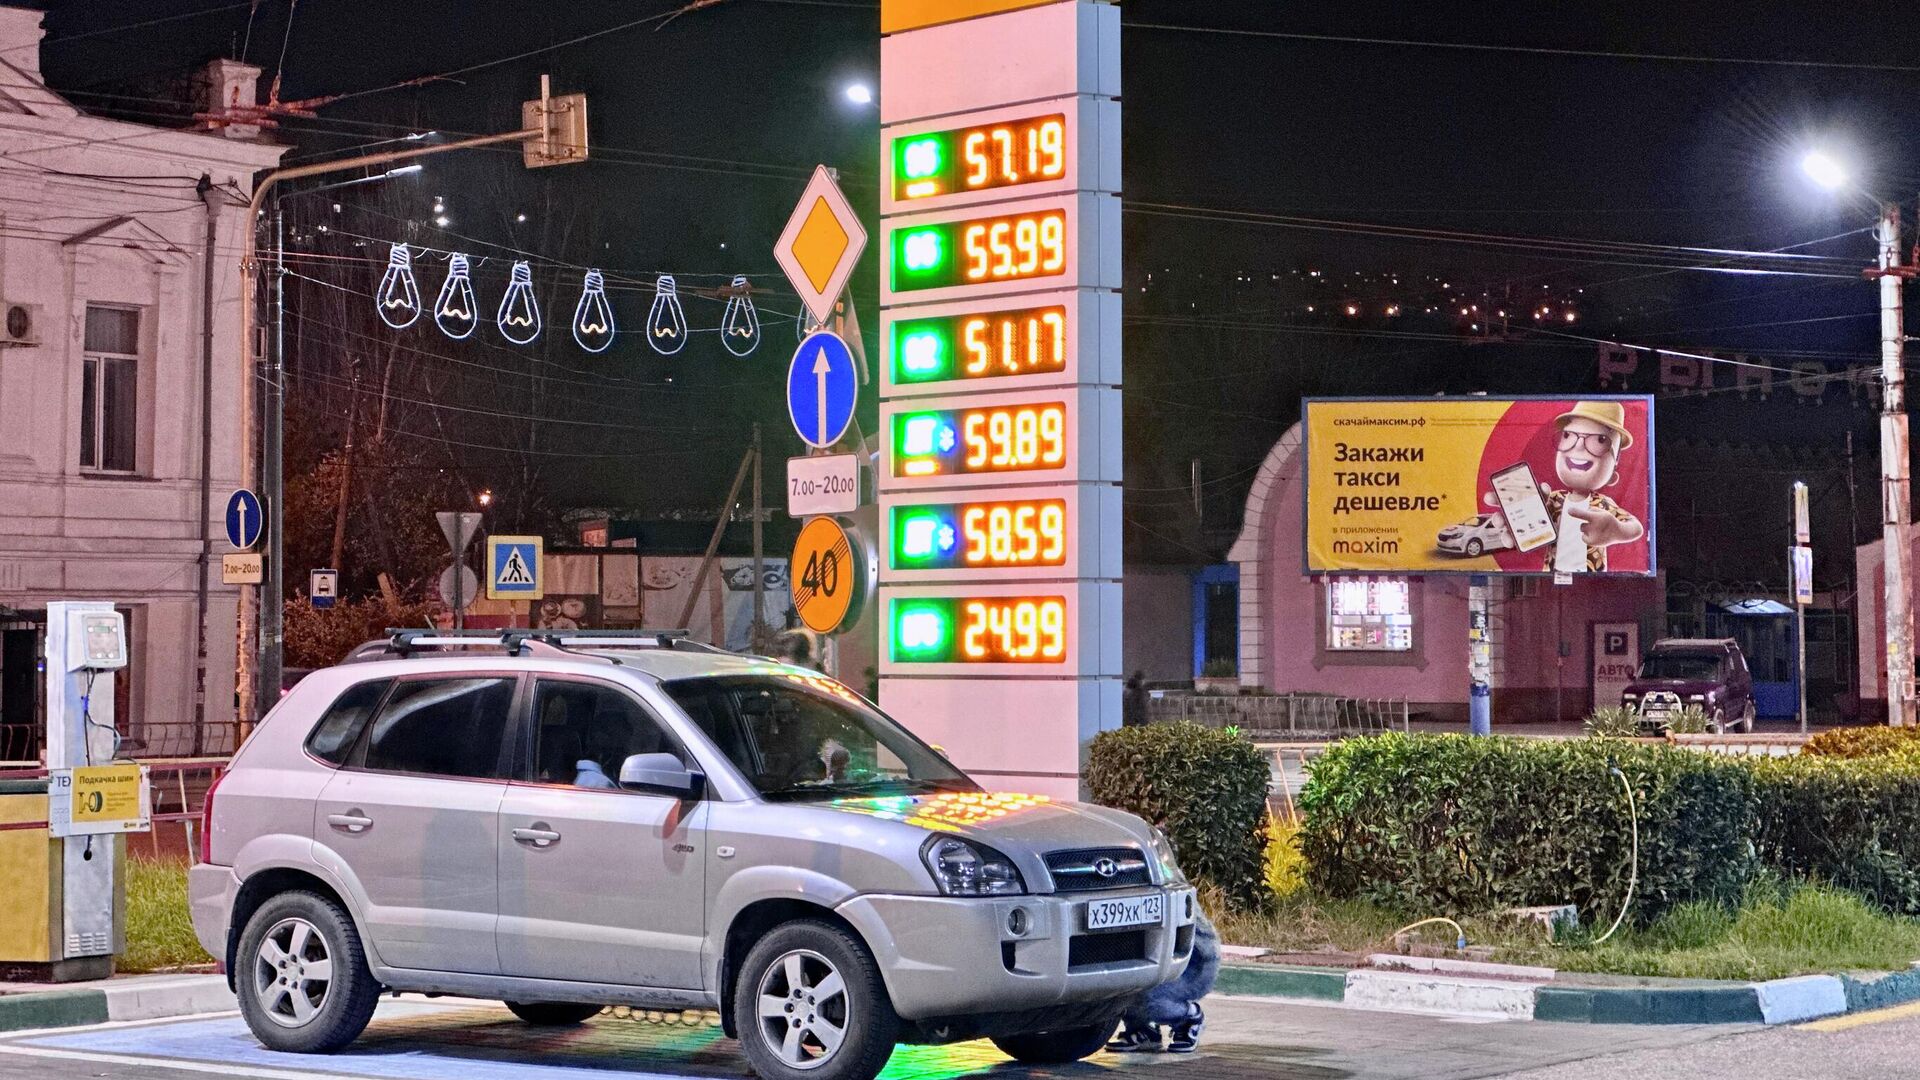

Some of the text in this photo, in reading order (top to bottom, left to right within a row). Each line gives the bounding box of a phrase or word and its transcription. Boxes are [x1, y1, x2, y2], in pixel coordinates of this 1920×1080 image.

[965, 121, 1063, 185] 57.19
[965, 215, 1063, 278] 55.99
[965, 312, 1063, 373] 51.17
[1333, 415, 1426, 428] скачаймаксим.рф
[964, 408, 1063, 467] 59.89
[1334, 442, 1425, 462] Закажи
[791, 475, 854, 496] 7.00-20.00
[1334, 471, 1400, 487] такси
[964, 504, 1063, 562] 58.59
[1340, 526, 1399, 535] приложении
[1333, 536, 1398, 554] maxim
[801, 549, 838, 598] 40
[964, 602, 1063, 657] 24.99
[79, 775, 134, 785] Подкачка шин
[1143, 897, 1159, 914] 123
